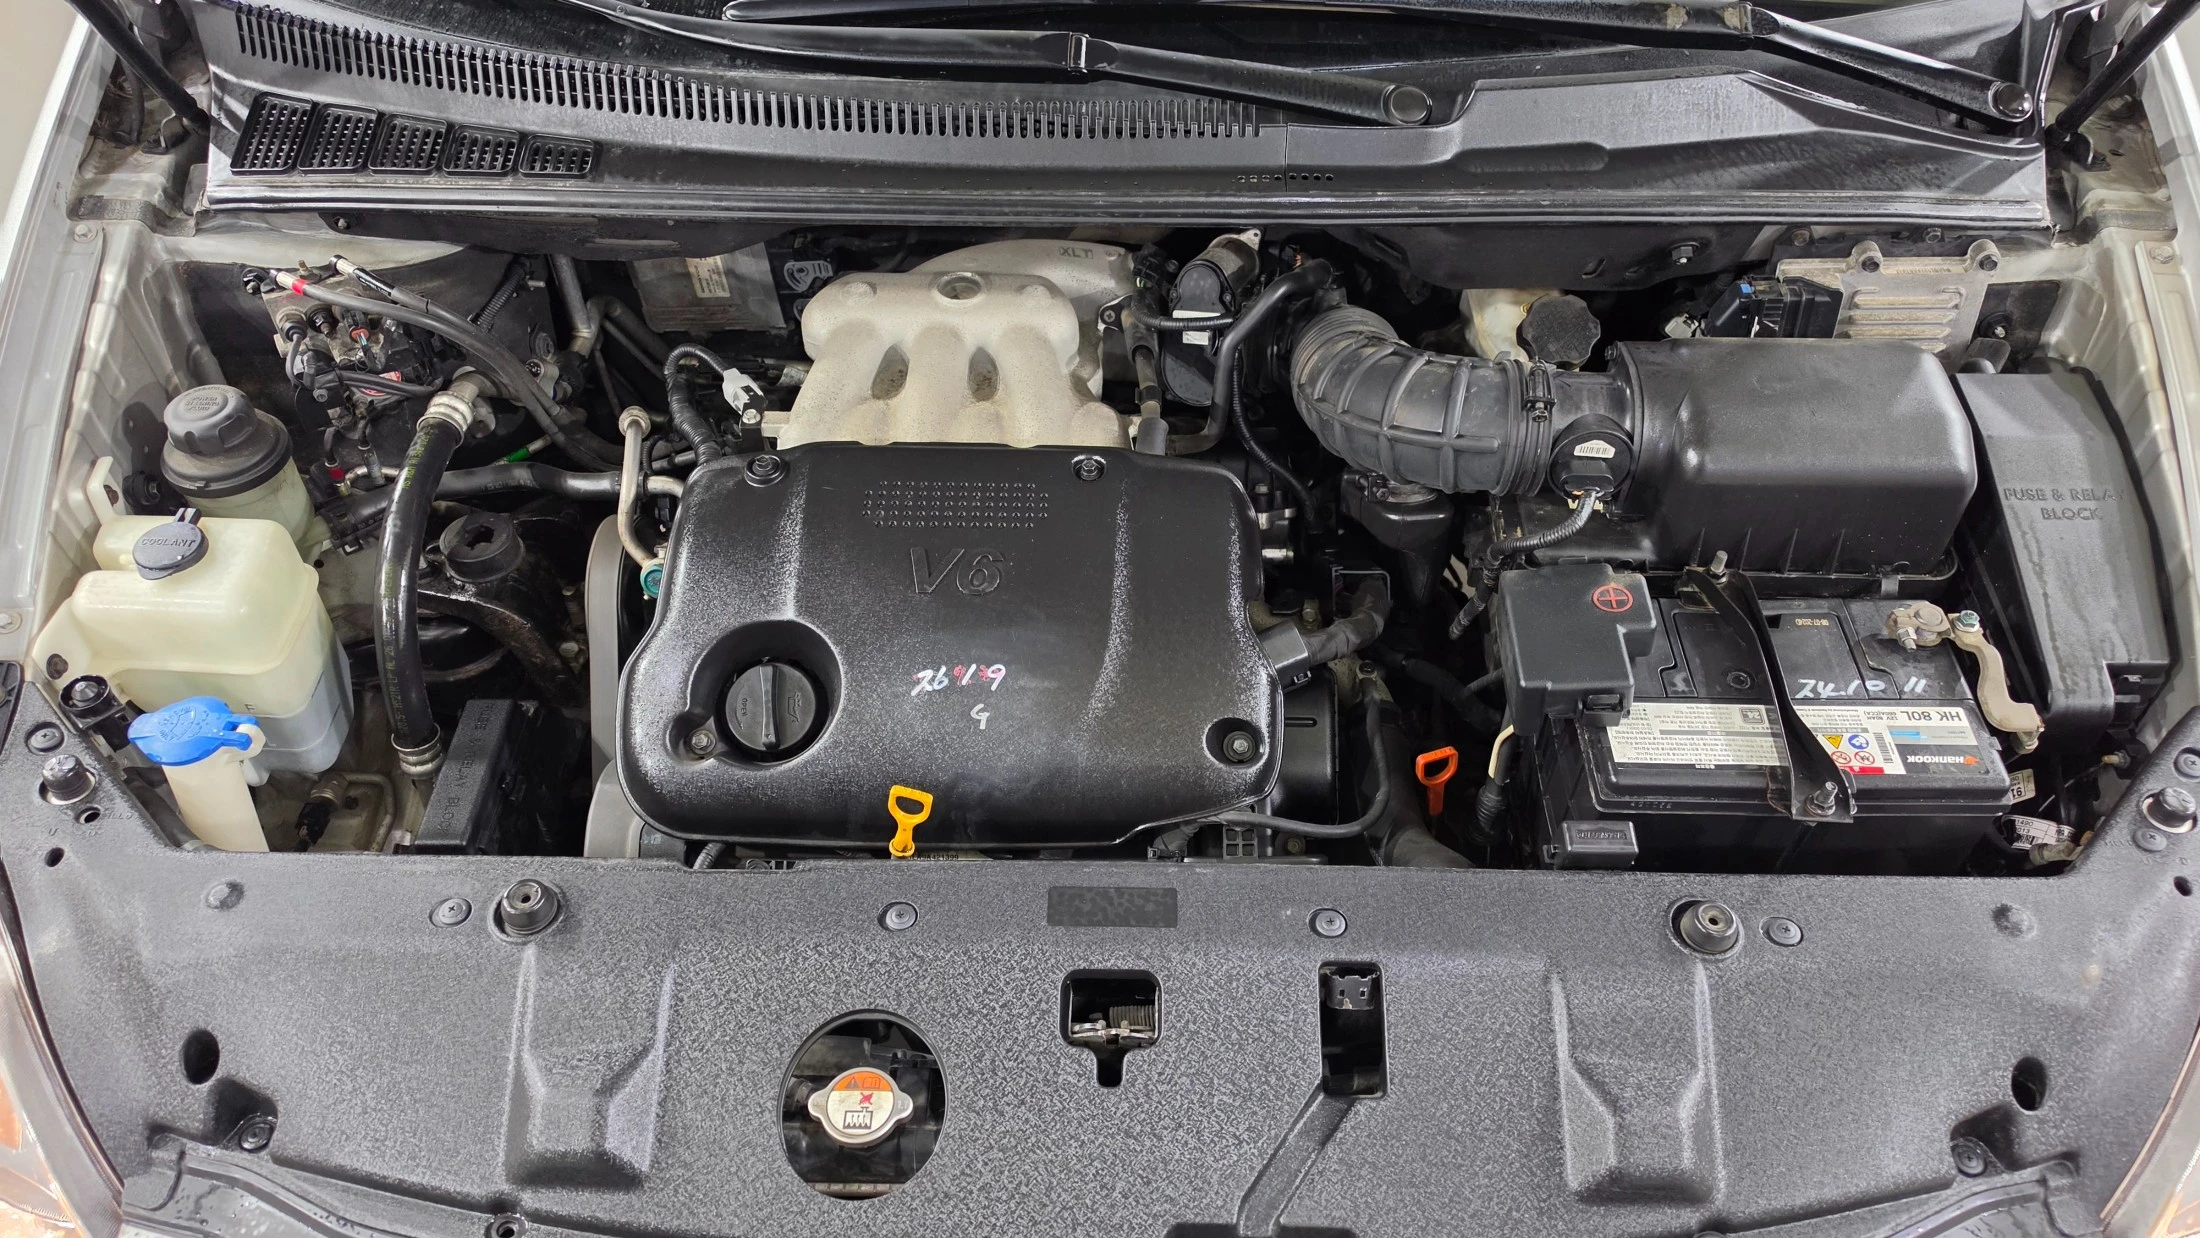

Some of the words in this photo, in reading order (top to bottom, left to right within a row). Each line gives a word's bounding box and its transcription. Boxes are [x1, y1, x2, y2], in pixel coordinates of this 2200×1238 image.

[2004, 488, 2048, 501] FUSE
[2052, 488, 2064, 501] &
[2040, 507, 2103, 520] BLOCK
[141, 538, 196, 547] COOLANT
[910, 547, 1004, 595] V6
[1900, 711, 1932, 721] 80L
[1935, 711, 1961, 721] HK
